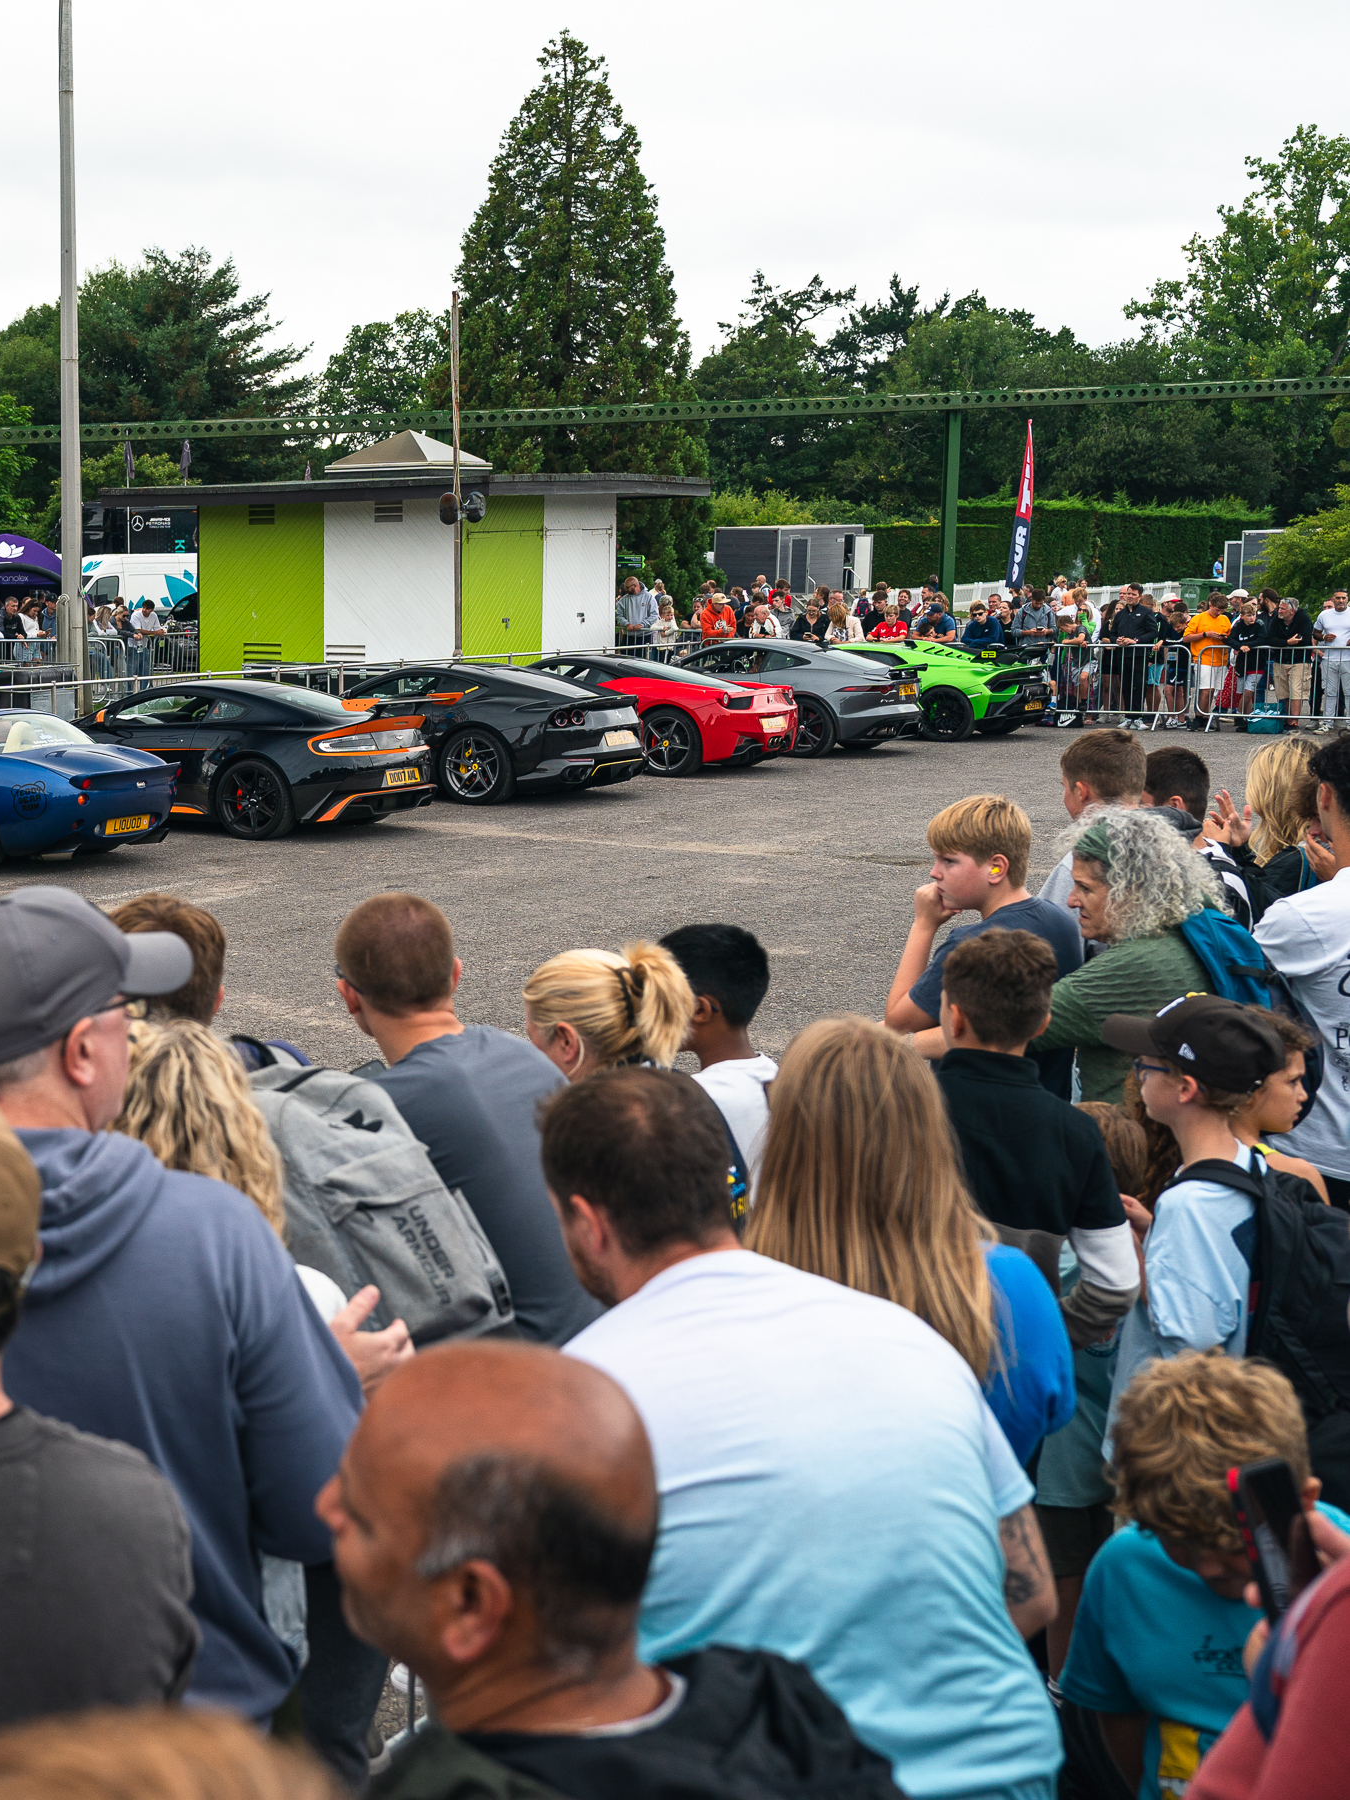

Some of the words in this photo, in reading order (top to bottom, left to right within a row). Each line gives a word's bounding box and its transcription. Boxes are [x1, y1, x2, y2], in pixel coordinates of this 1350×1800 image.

[981, 650, 997, 658] 63
[16, 787, 45, 797] TEDDY
[18, 794, 42, 805] BEAR
[21, 803, 40, 811] RUN
[408, 1204, 456, 1279] UNDER
[390, 1215, 451, 1305] ARMOUR
